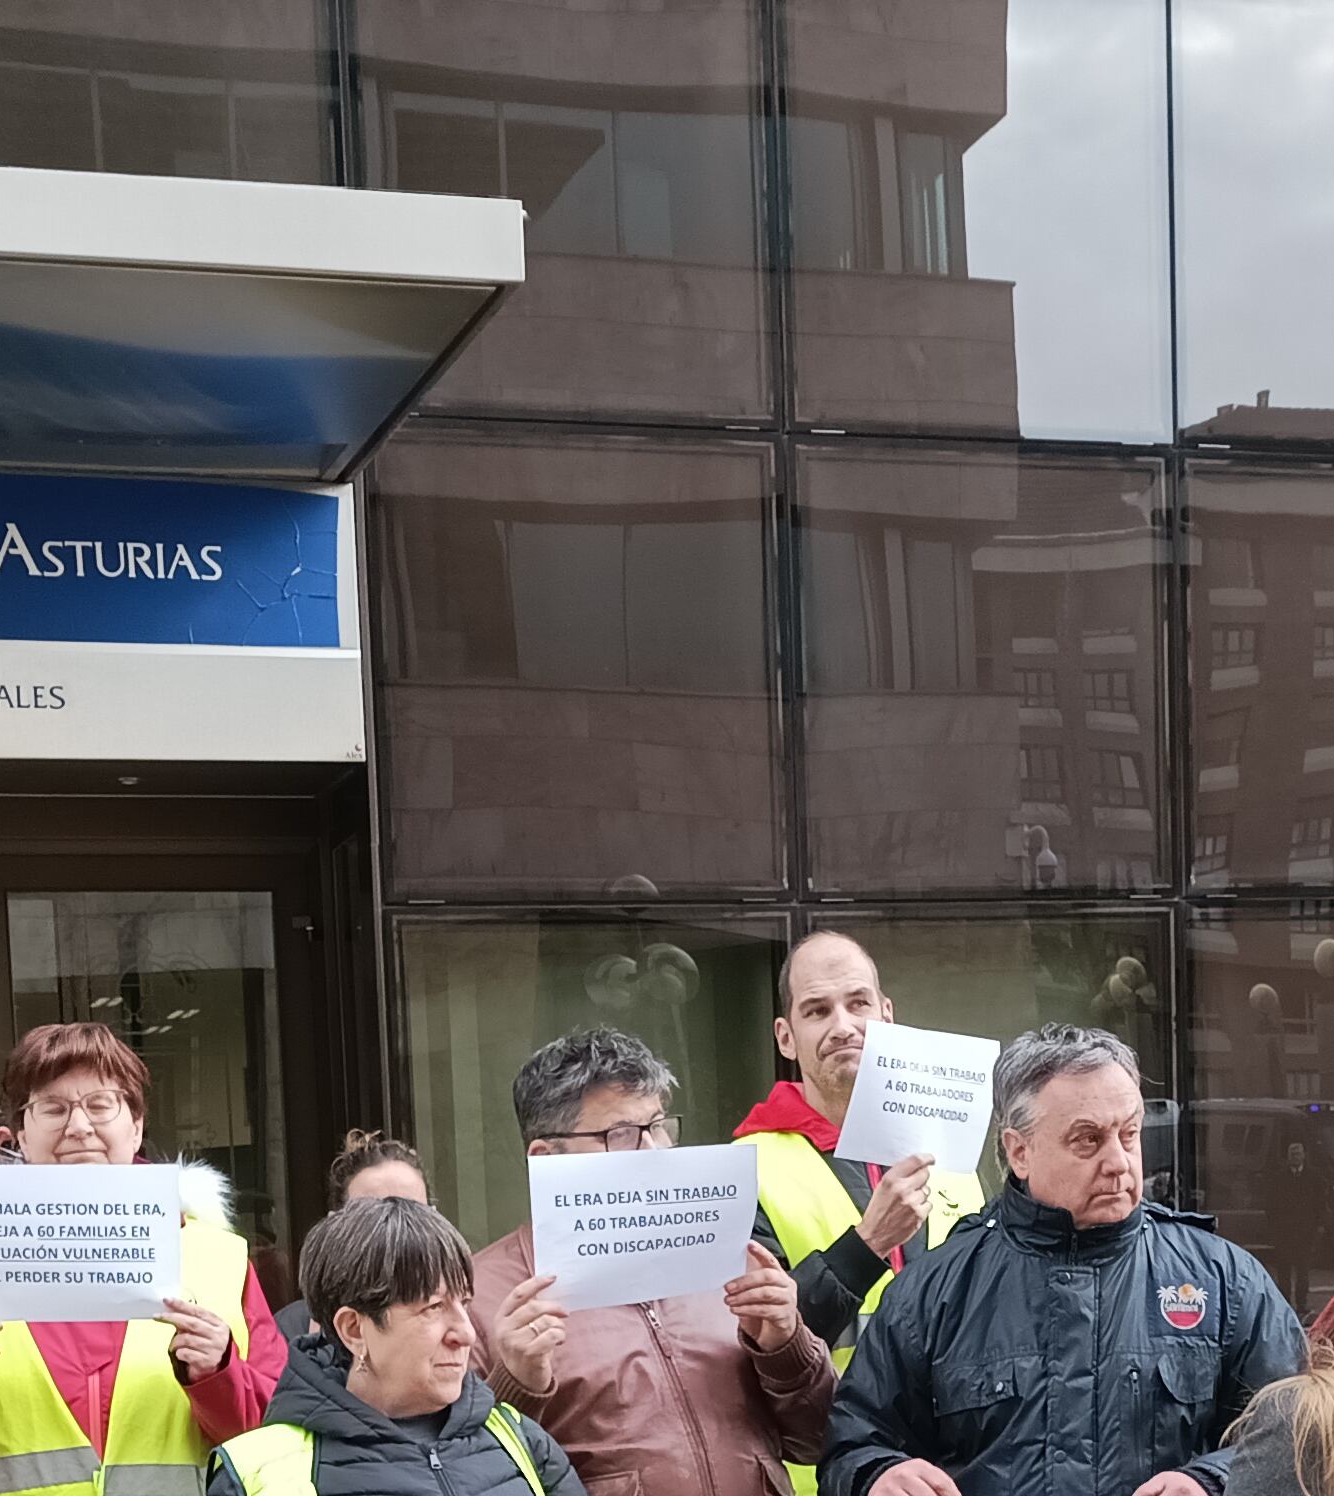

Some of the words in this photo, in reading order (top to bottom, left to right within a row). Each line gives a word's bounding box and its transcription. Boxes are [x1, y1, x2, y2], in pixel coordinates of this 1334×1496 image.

[877, 1056, 888, 1068] EL
[890, 1058, 907, 1069] ERA
[931, 1065, 947, 1077] SIN
[949, 1067, 986, 1083] TRABAJO
[885, 1080, 893, 1091] A
[895, 1081, 908, 1093] 60
[909, 1082, 974, 1102] TRABAJADORES
[882, 1101, 906, 1114] CON
[908, 1104, 968, 1123] DISCAPACIDAD
[554, 1195, 570, 1207] EL
[574, 1193, 603, 1207] ERA
[607, 1191, 642, 1205] DEJA
[645, 1189, 669, 1203] SIN
[673, 1184, 737, 1200] TRABAJO
[35, 1203, 99, 1216] GESTION
[103, 1203, 130, 1216] DEL
[133, 1203, 166, 1218] ERA,
[574, 1219, 585, 1232] A
[588, 1218, 606, 1231] 60
[609, 1210, 720, 1229] TRABAJADORES
[22, 1225, 34, 1238] A
[37, 1225, 55, 1238] 60
[59, 1225, 127, 1238] FAMILIAS
[131, 1225, 150, 1238] EN
[62, 1247, 156, 1259] VULNERABLE
[577, 1243, 609, 1256] CON
[613, 1232, 716, 1254] DISCAPACIDAD
[5, 1271, 61, 1284] PERDER
[64, 1271, 84, 1284] SU
[87, 1271, 153, 1284] TRABAJO
